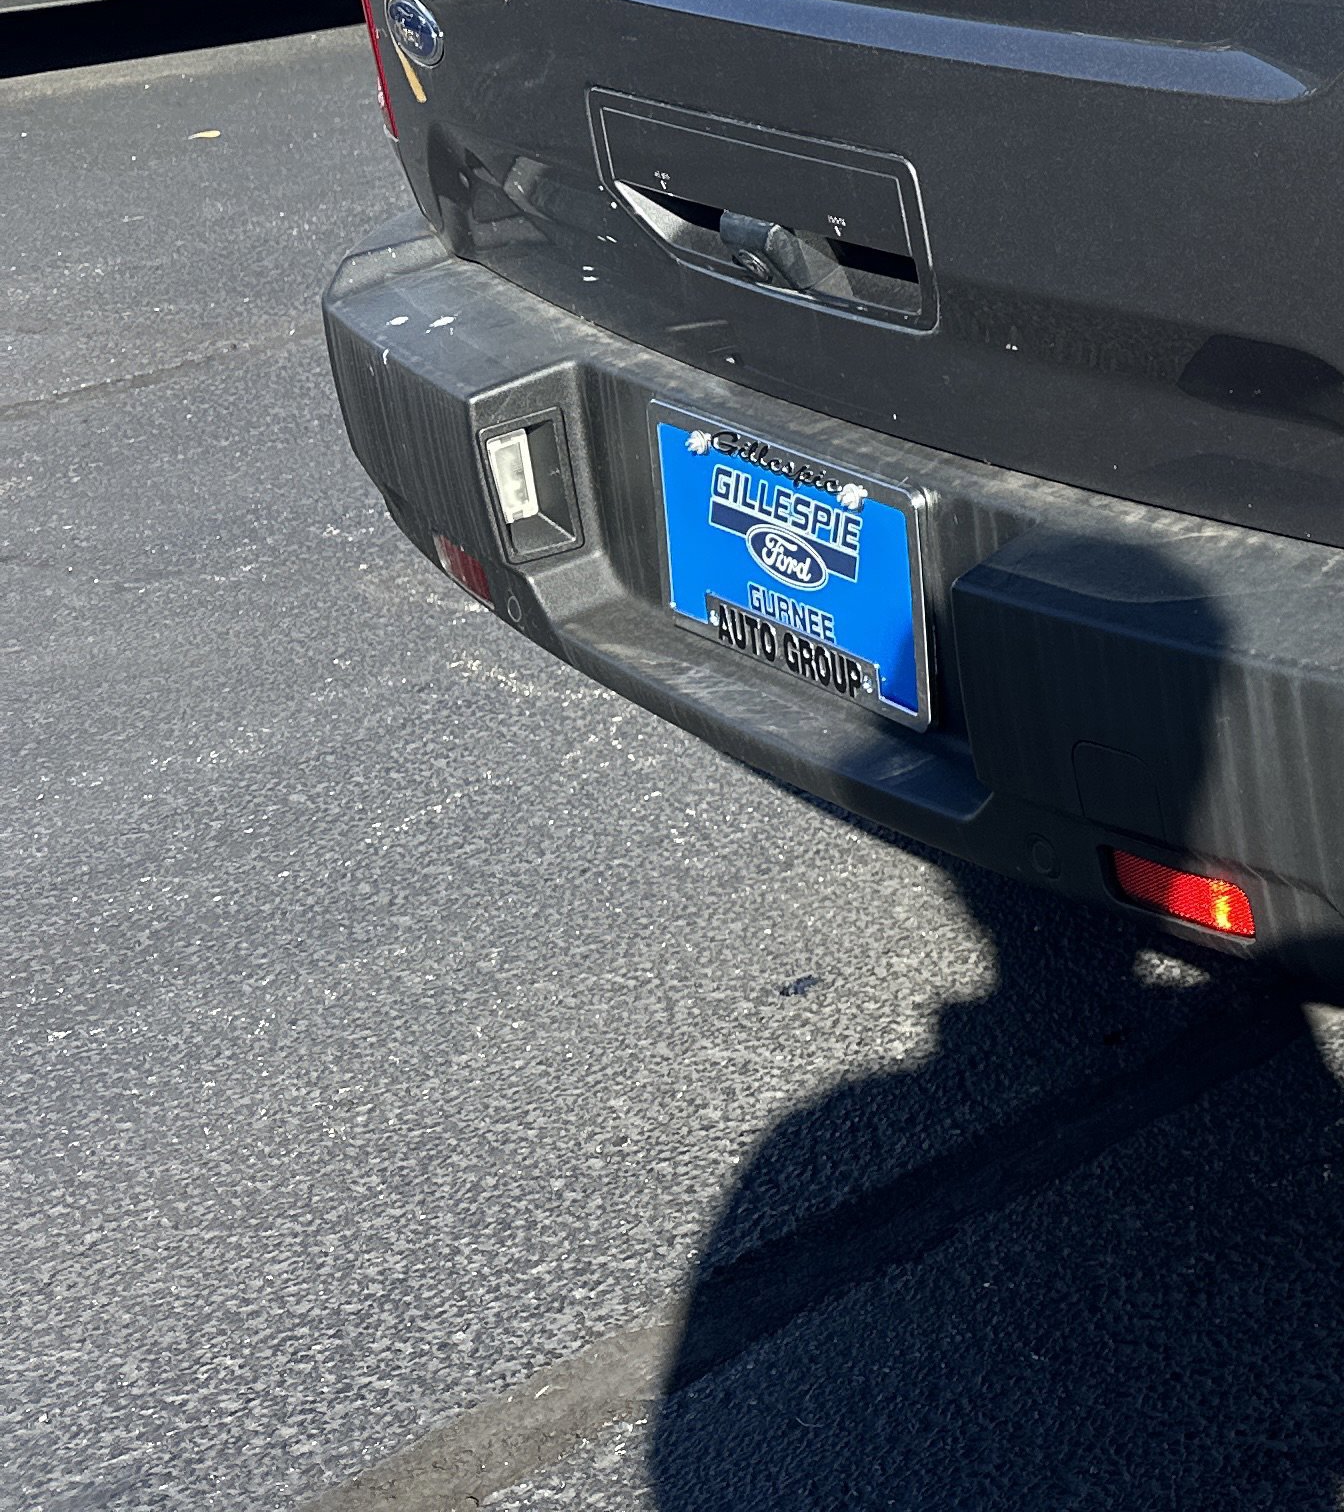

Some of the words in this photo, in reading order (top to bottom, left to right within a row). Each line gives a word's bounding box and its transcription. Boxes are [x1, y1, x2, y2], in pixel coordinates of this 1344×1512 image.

[709, 430, 844, 495] Gillespie
[710, 463, 863, 552] GILLESPIE
[760, 536, 813, 583] Ford
[746, 581, 837, 645] GURNEE
[716, 603, 777, 663] AUTO
[783, 631, 863, 699] GROUP
